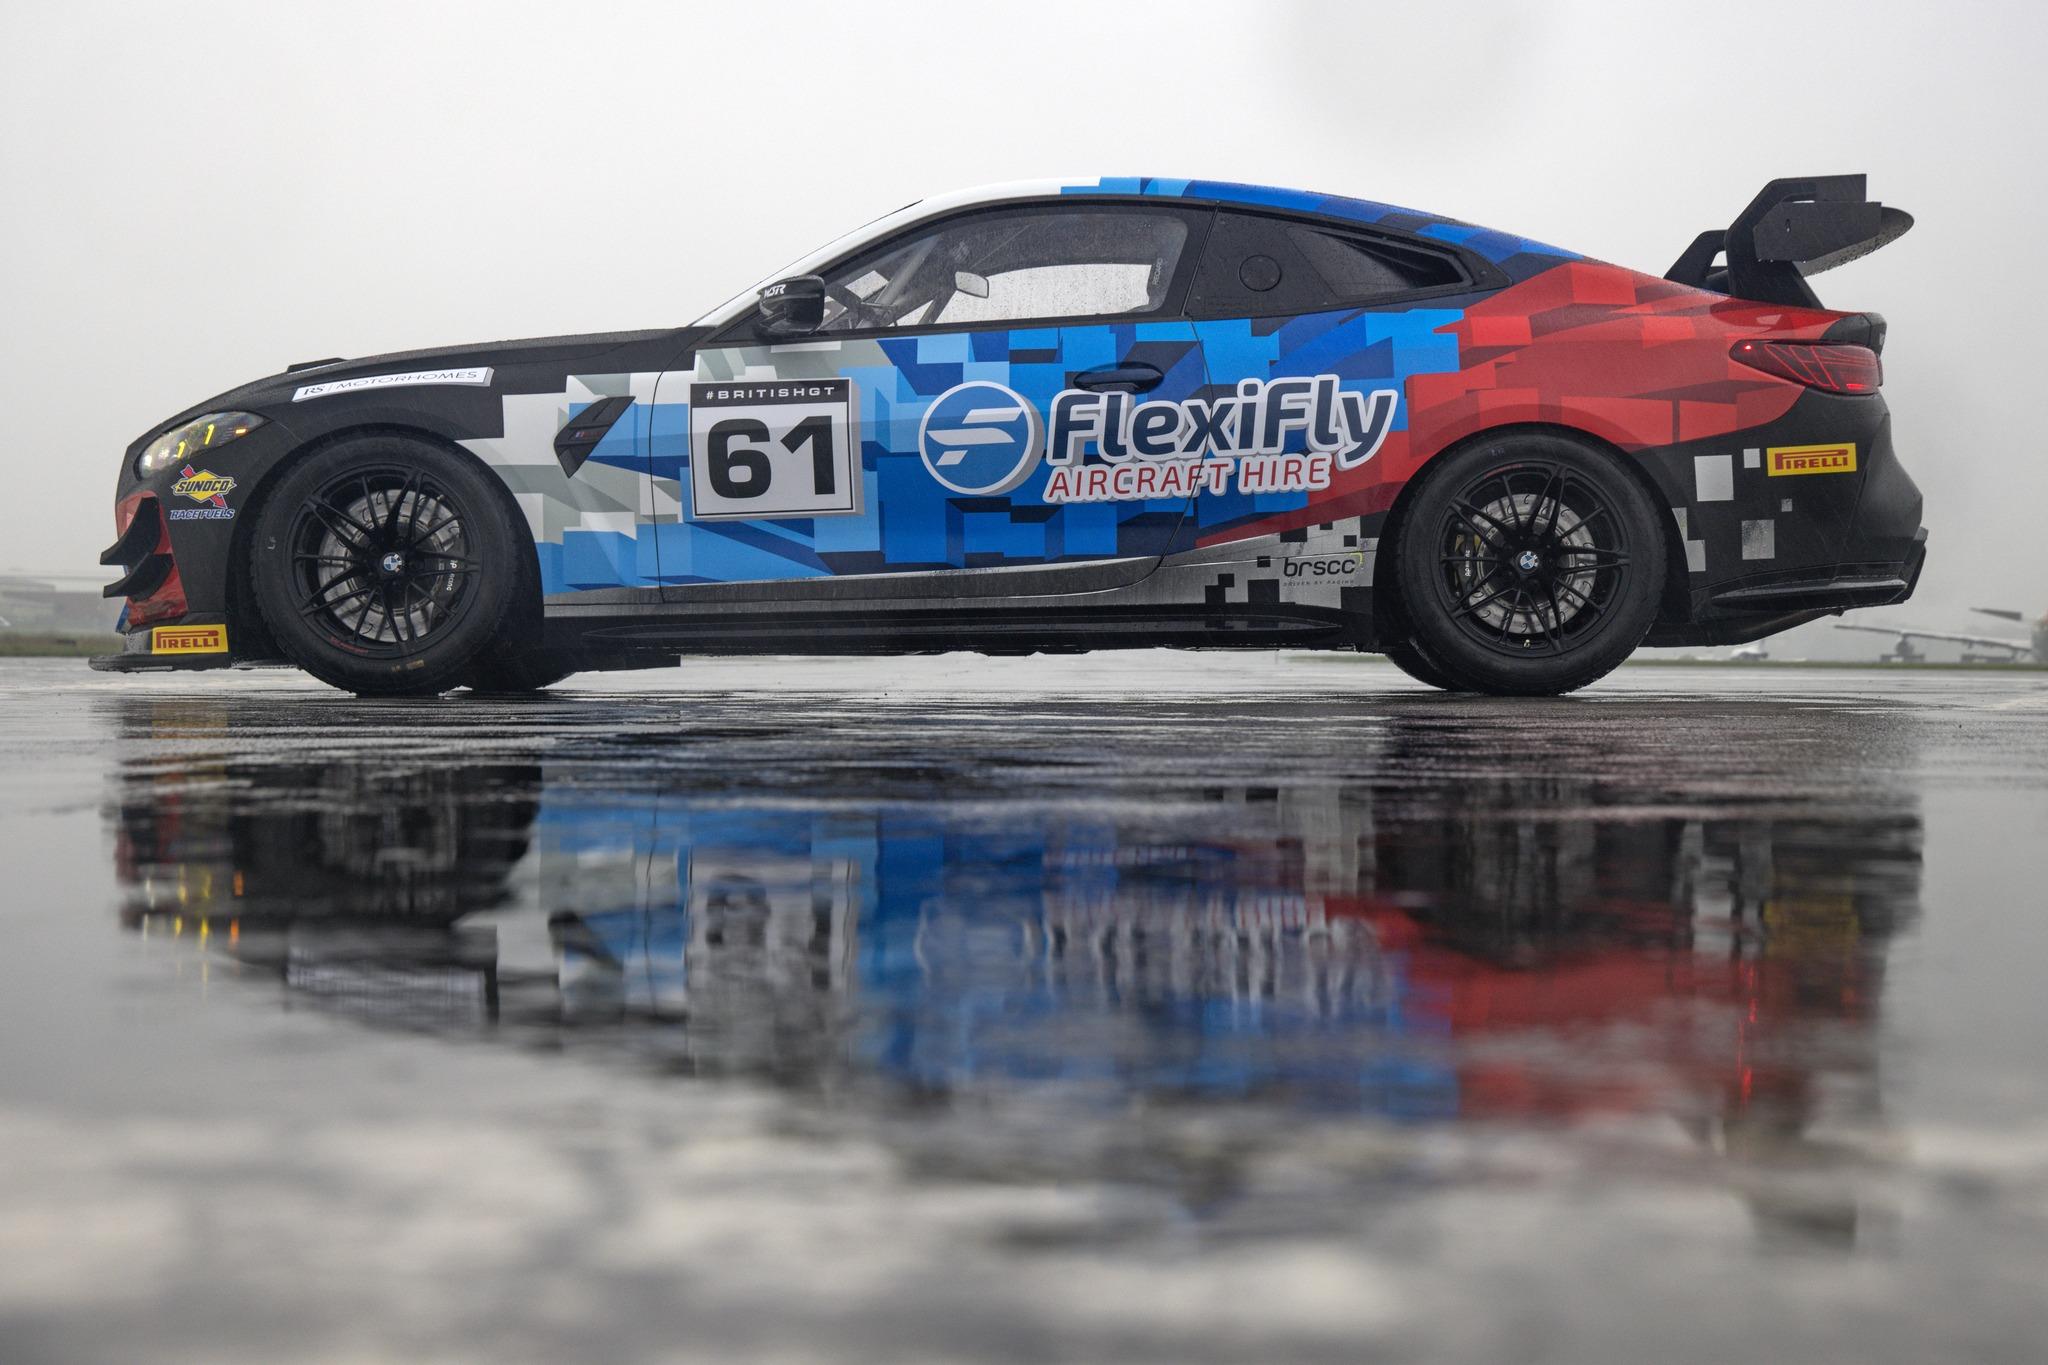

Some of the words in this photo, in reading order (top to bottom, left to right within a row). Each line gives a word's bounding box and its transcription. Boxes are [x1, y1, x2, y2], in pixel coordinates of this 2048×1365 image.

[763, 284, 787, 299] WSR
[303, 385, 324, 396] RS
[335, 370, 478, 390] MOTORHOMES
[706, 386, 836, 400] #BRITISHGT
[1050, 377, 1396, 466] FlexiFly
[707, 414, 836, 499] 61
[1774, 448, 1849, 470] PIRELLI
[176, 479, 231, 493] SUNOCO
[1048, 462, 1229, 498] AIRCRAFT
[1242, 457, 1328, 488] HIRE
[170, 509, 199, 520] RACE
[199, 508, 235, 520] FUELS
[1283, 557, 1356, 577] brscc
[156, 630, 219, 649] PIRELLI
